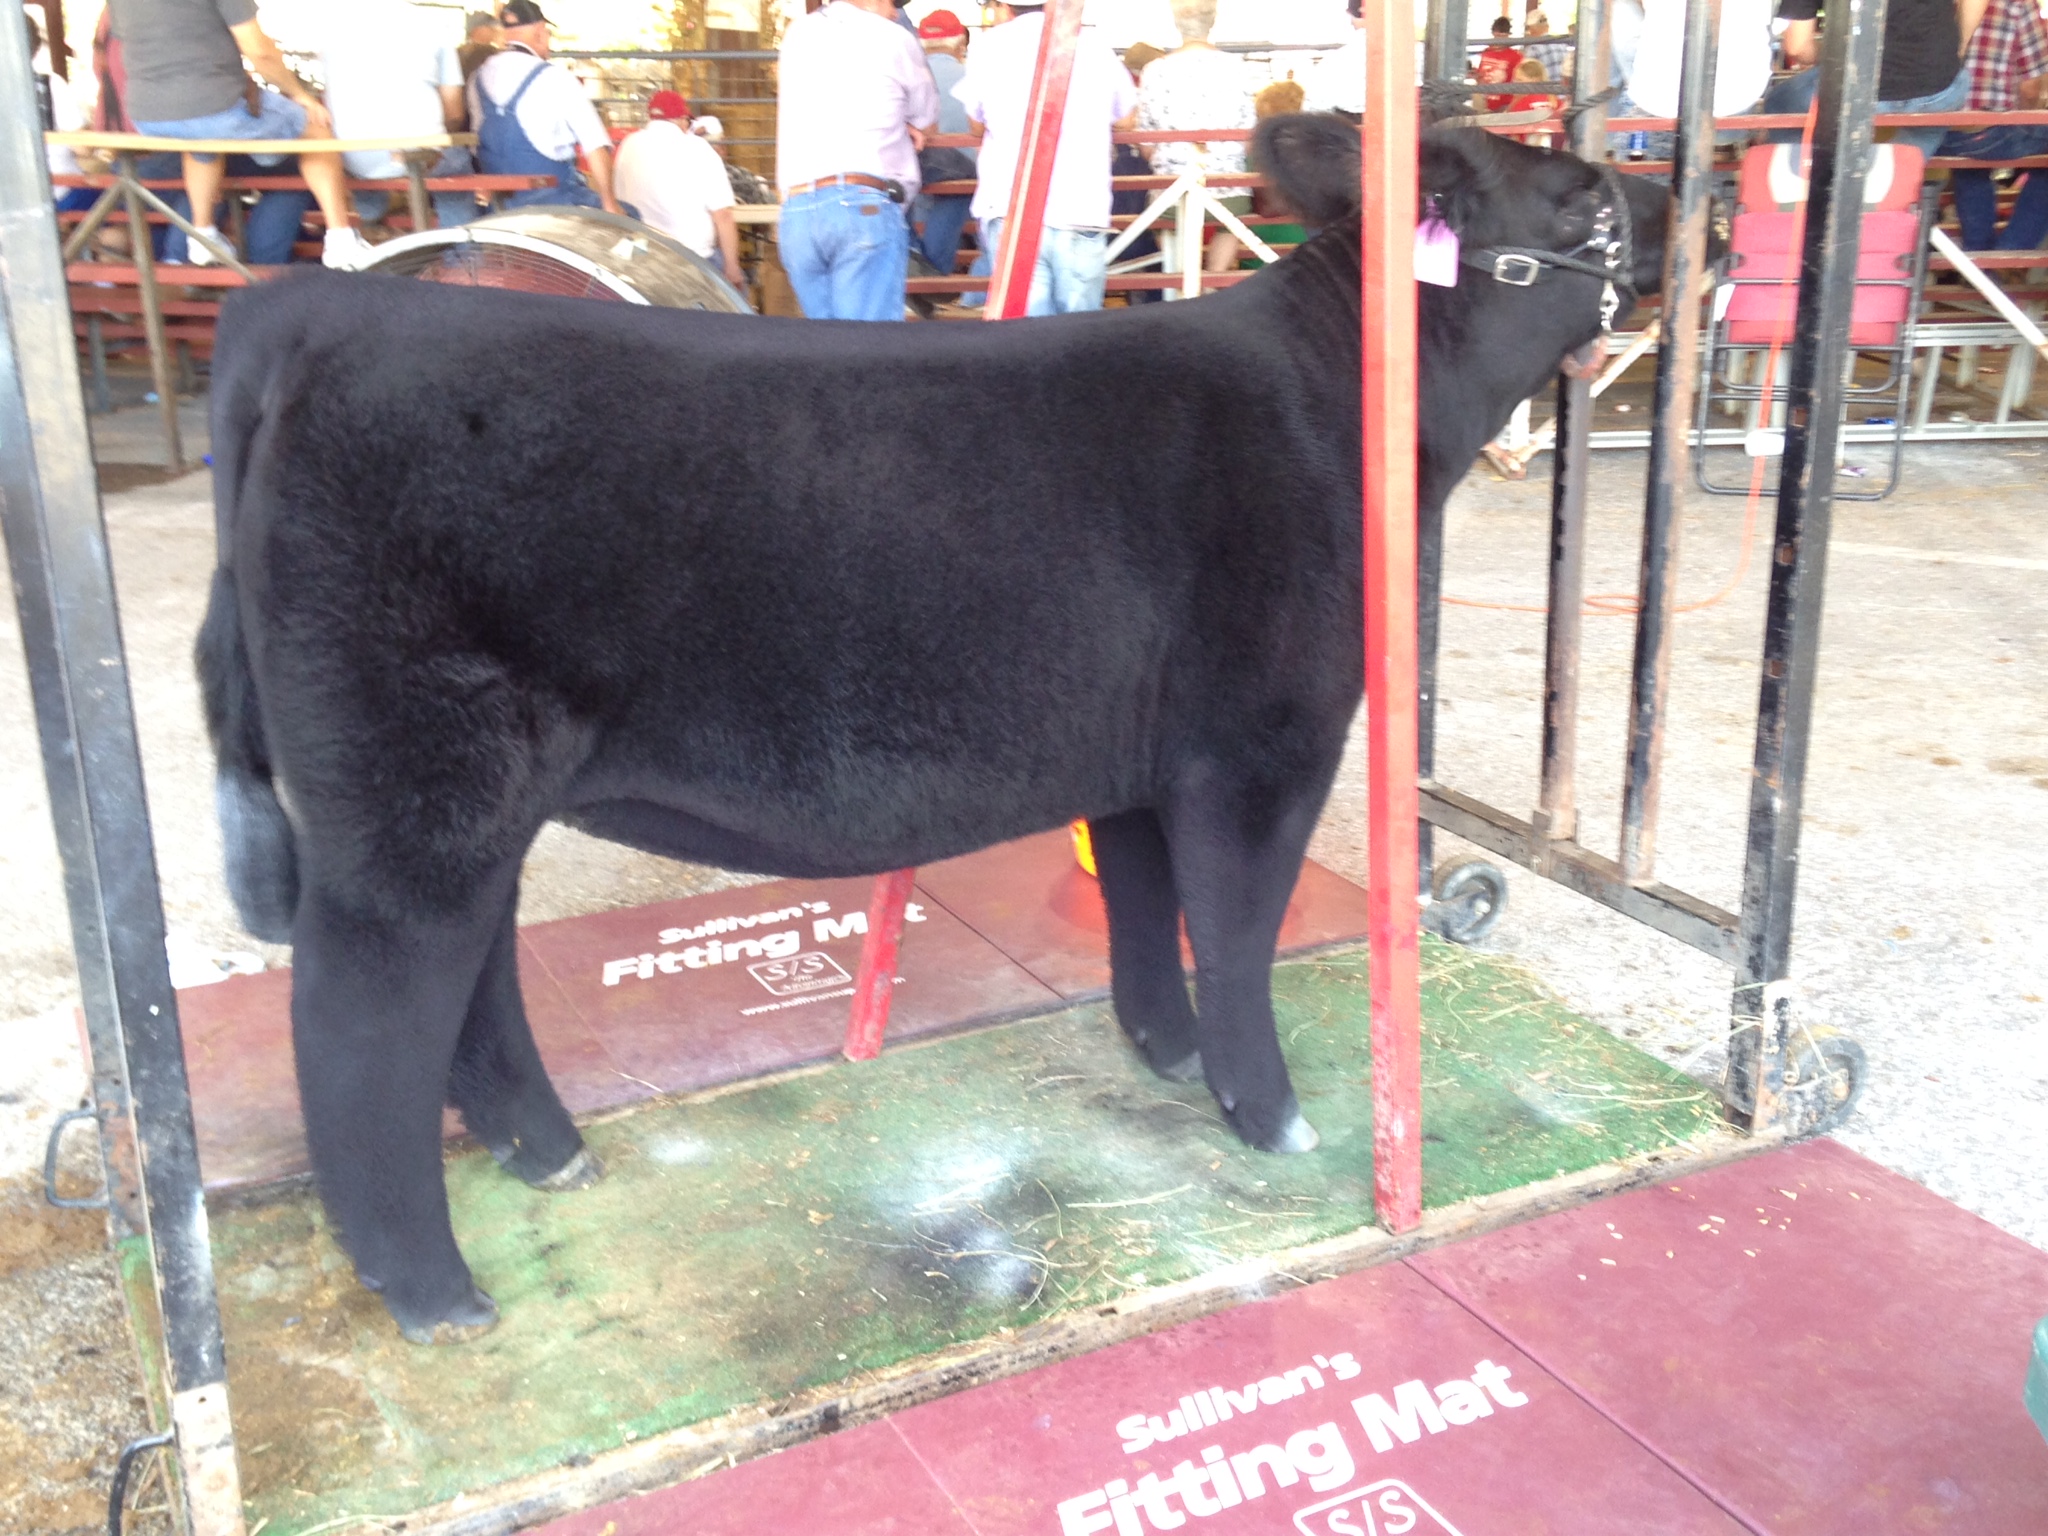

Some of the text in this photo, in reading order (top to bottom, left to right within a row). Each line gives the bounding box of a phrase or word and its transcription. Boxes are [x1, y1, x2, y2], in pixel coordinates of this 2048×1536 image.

[602, 902, 928, 987] Fitting Mt
[658, 901, 831, 945] Sullivan's
[1056, 1359, 1529, 1536] Fitting Mat
[1115, 1352, 1362, 1454] Sullivan's
